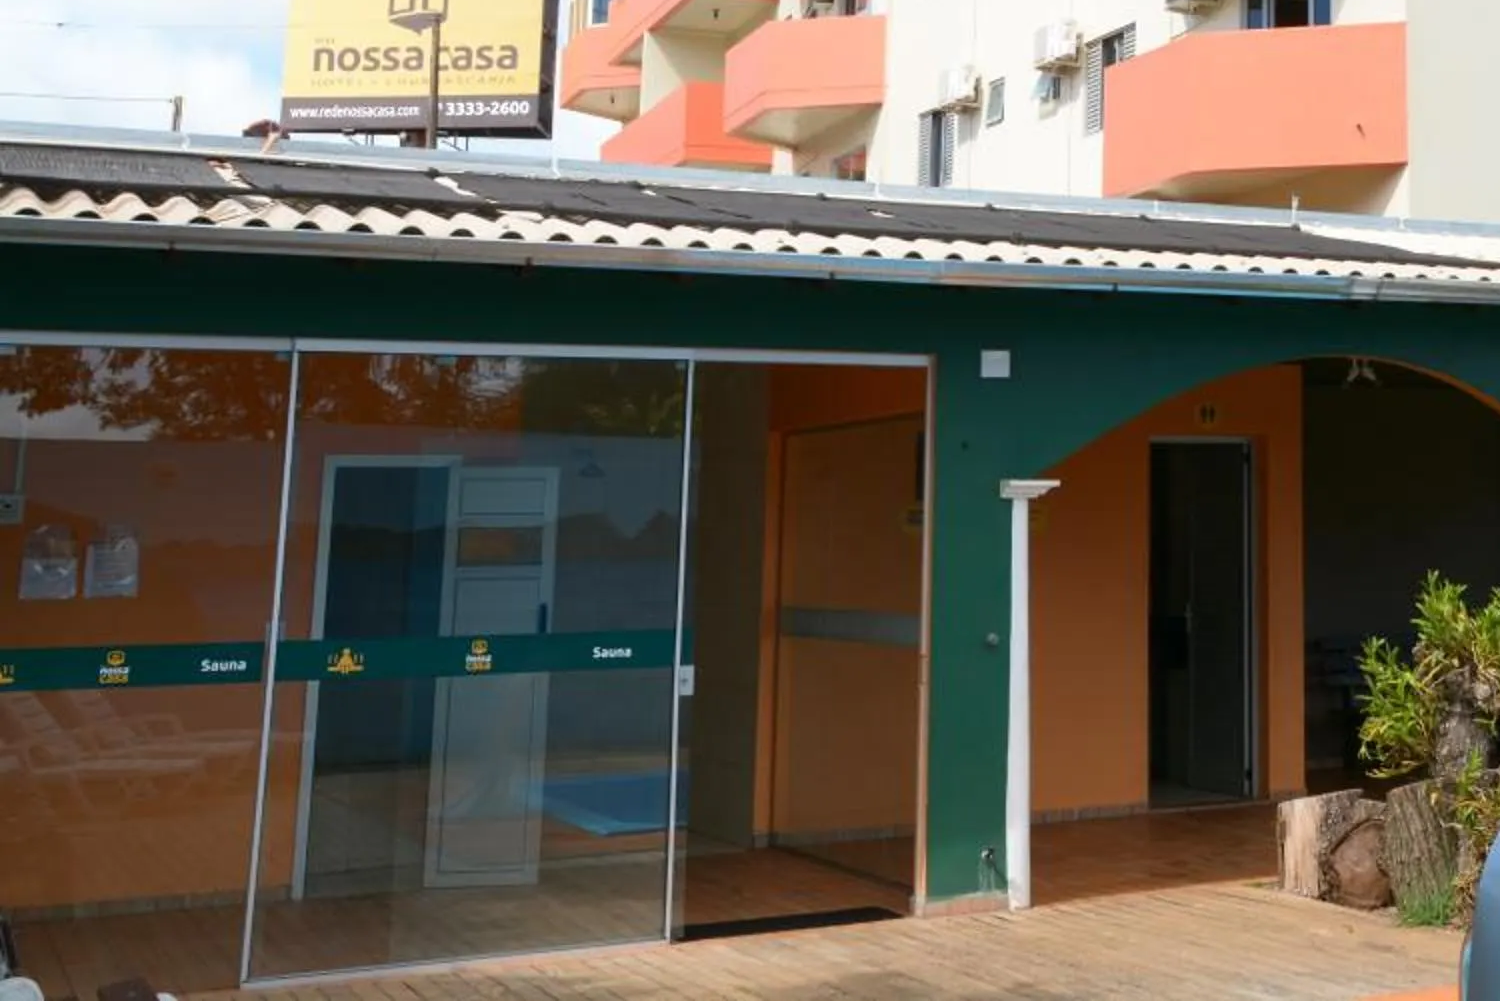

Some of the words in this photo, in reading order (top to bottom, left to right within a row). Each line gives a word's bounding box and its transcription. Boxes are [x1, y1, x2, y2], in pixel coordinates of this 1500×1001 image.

[313, 46, 424, 72] nossa
[438, 44, 519, 71] casa
[289, 104, 420, 118] www.redenossacasa.com
[445, 101, 530, 116] 3333-2600
[592, 646, 633, 659] Sauna
[200, 658, 248, 672] Sauna
